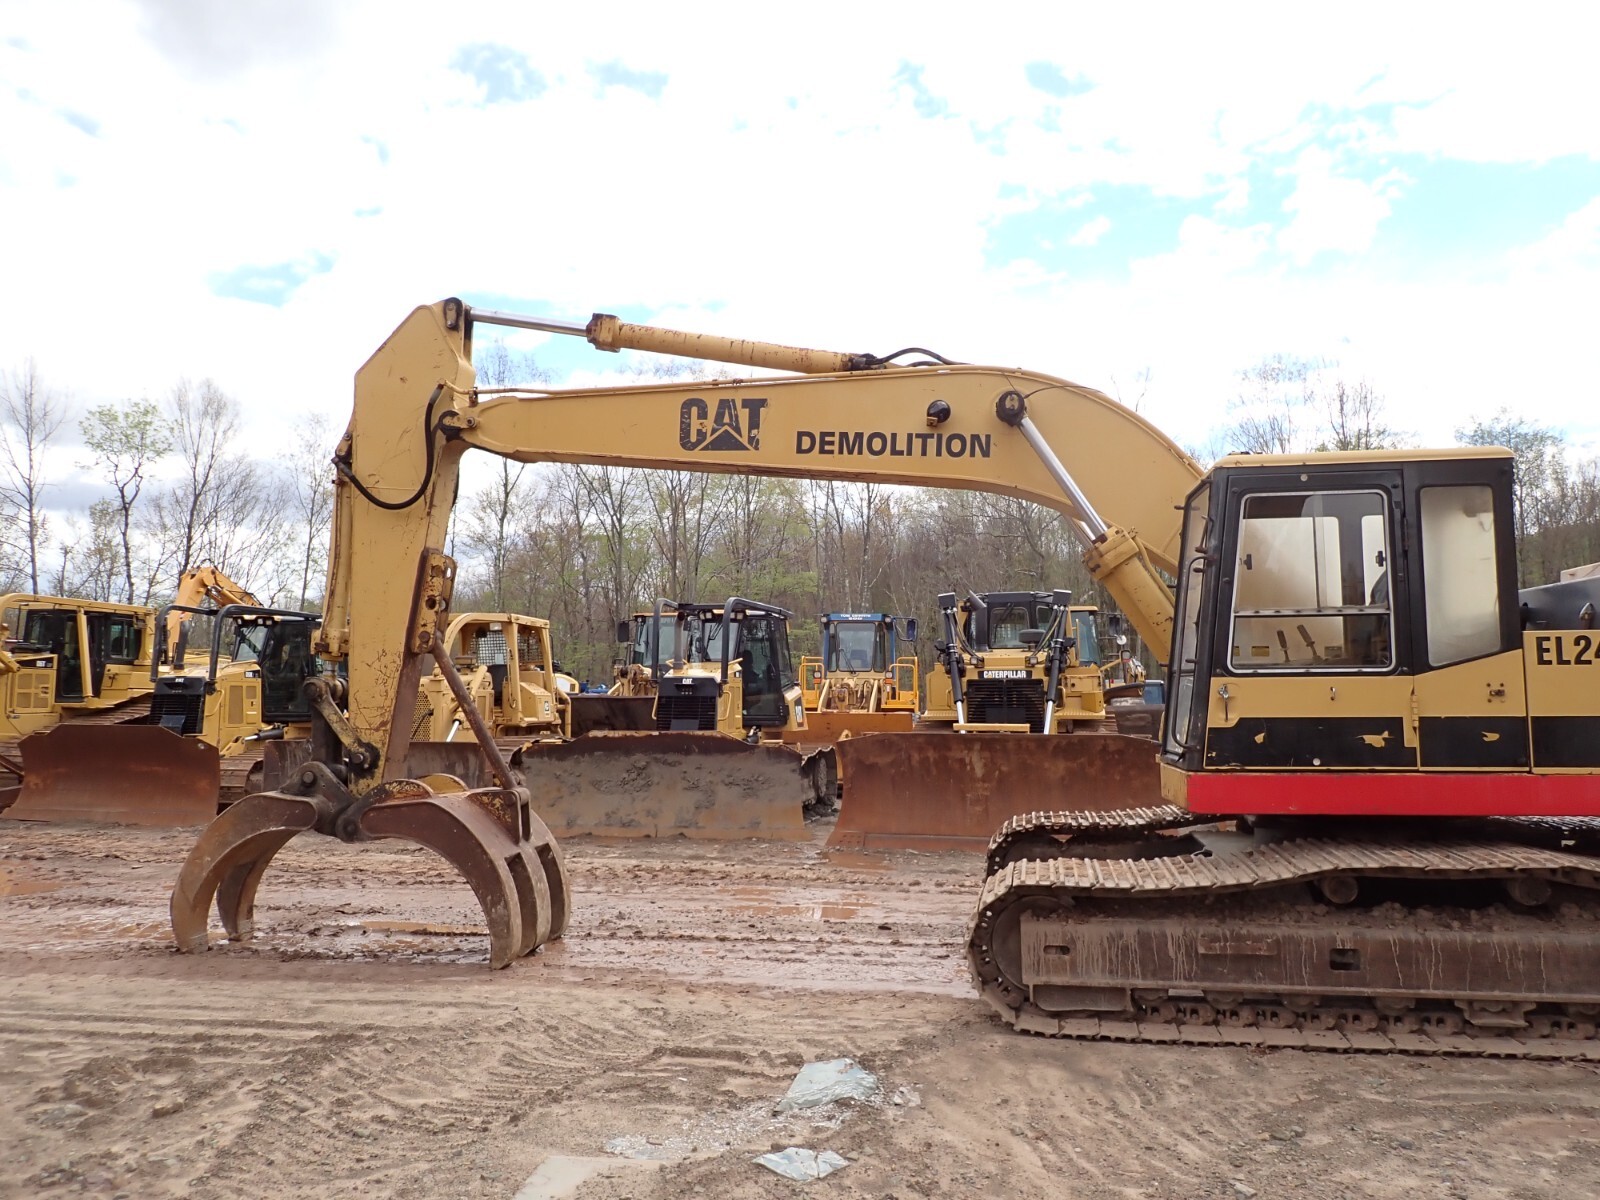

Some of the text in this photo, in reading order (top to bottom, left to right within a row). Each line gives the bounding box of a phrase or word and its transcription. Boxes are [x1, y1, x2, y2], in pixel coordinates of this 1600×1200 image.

[679, 397, 768, 451] CAT
[795, 430, 992, 459] DEMOLITION
[983, 670, 1027, 679] CATERPILLAR
